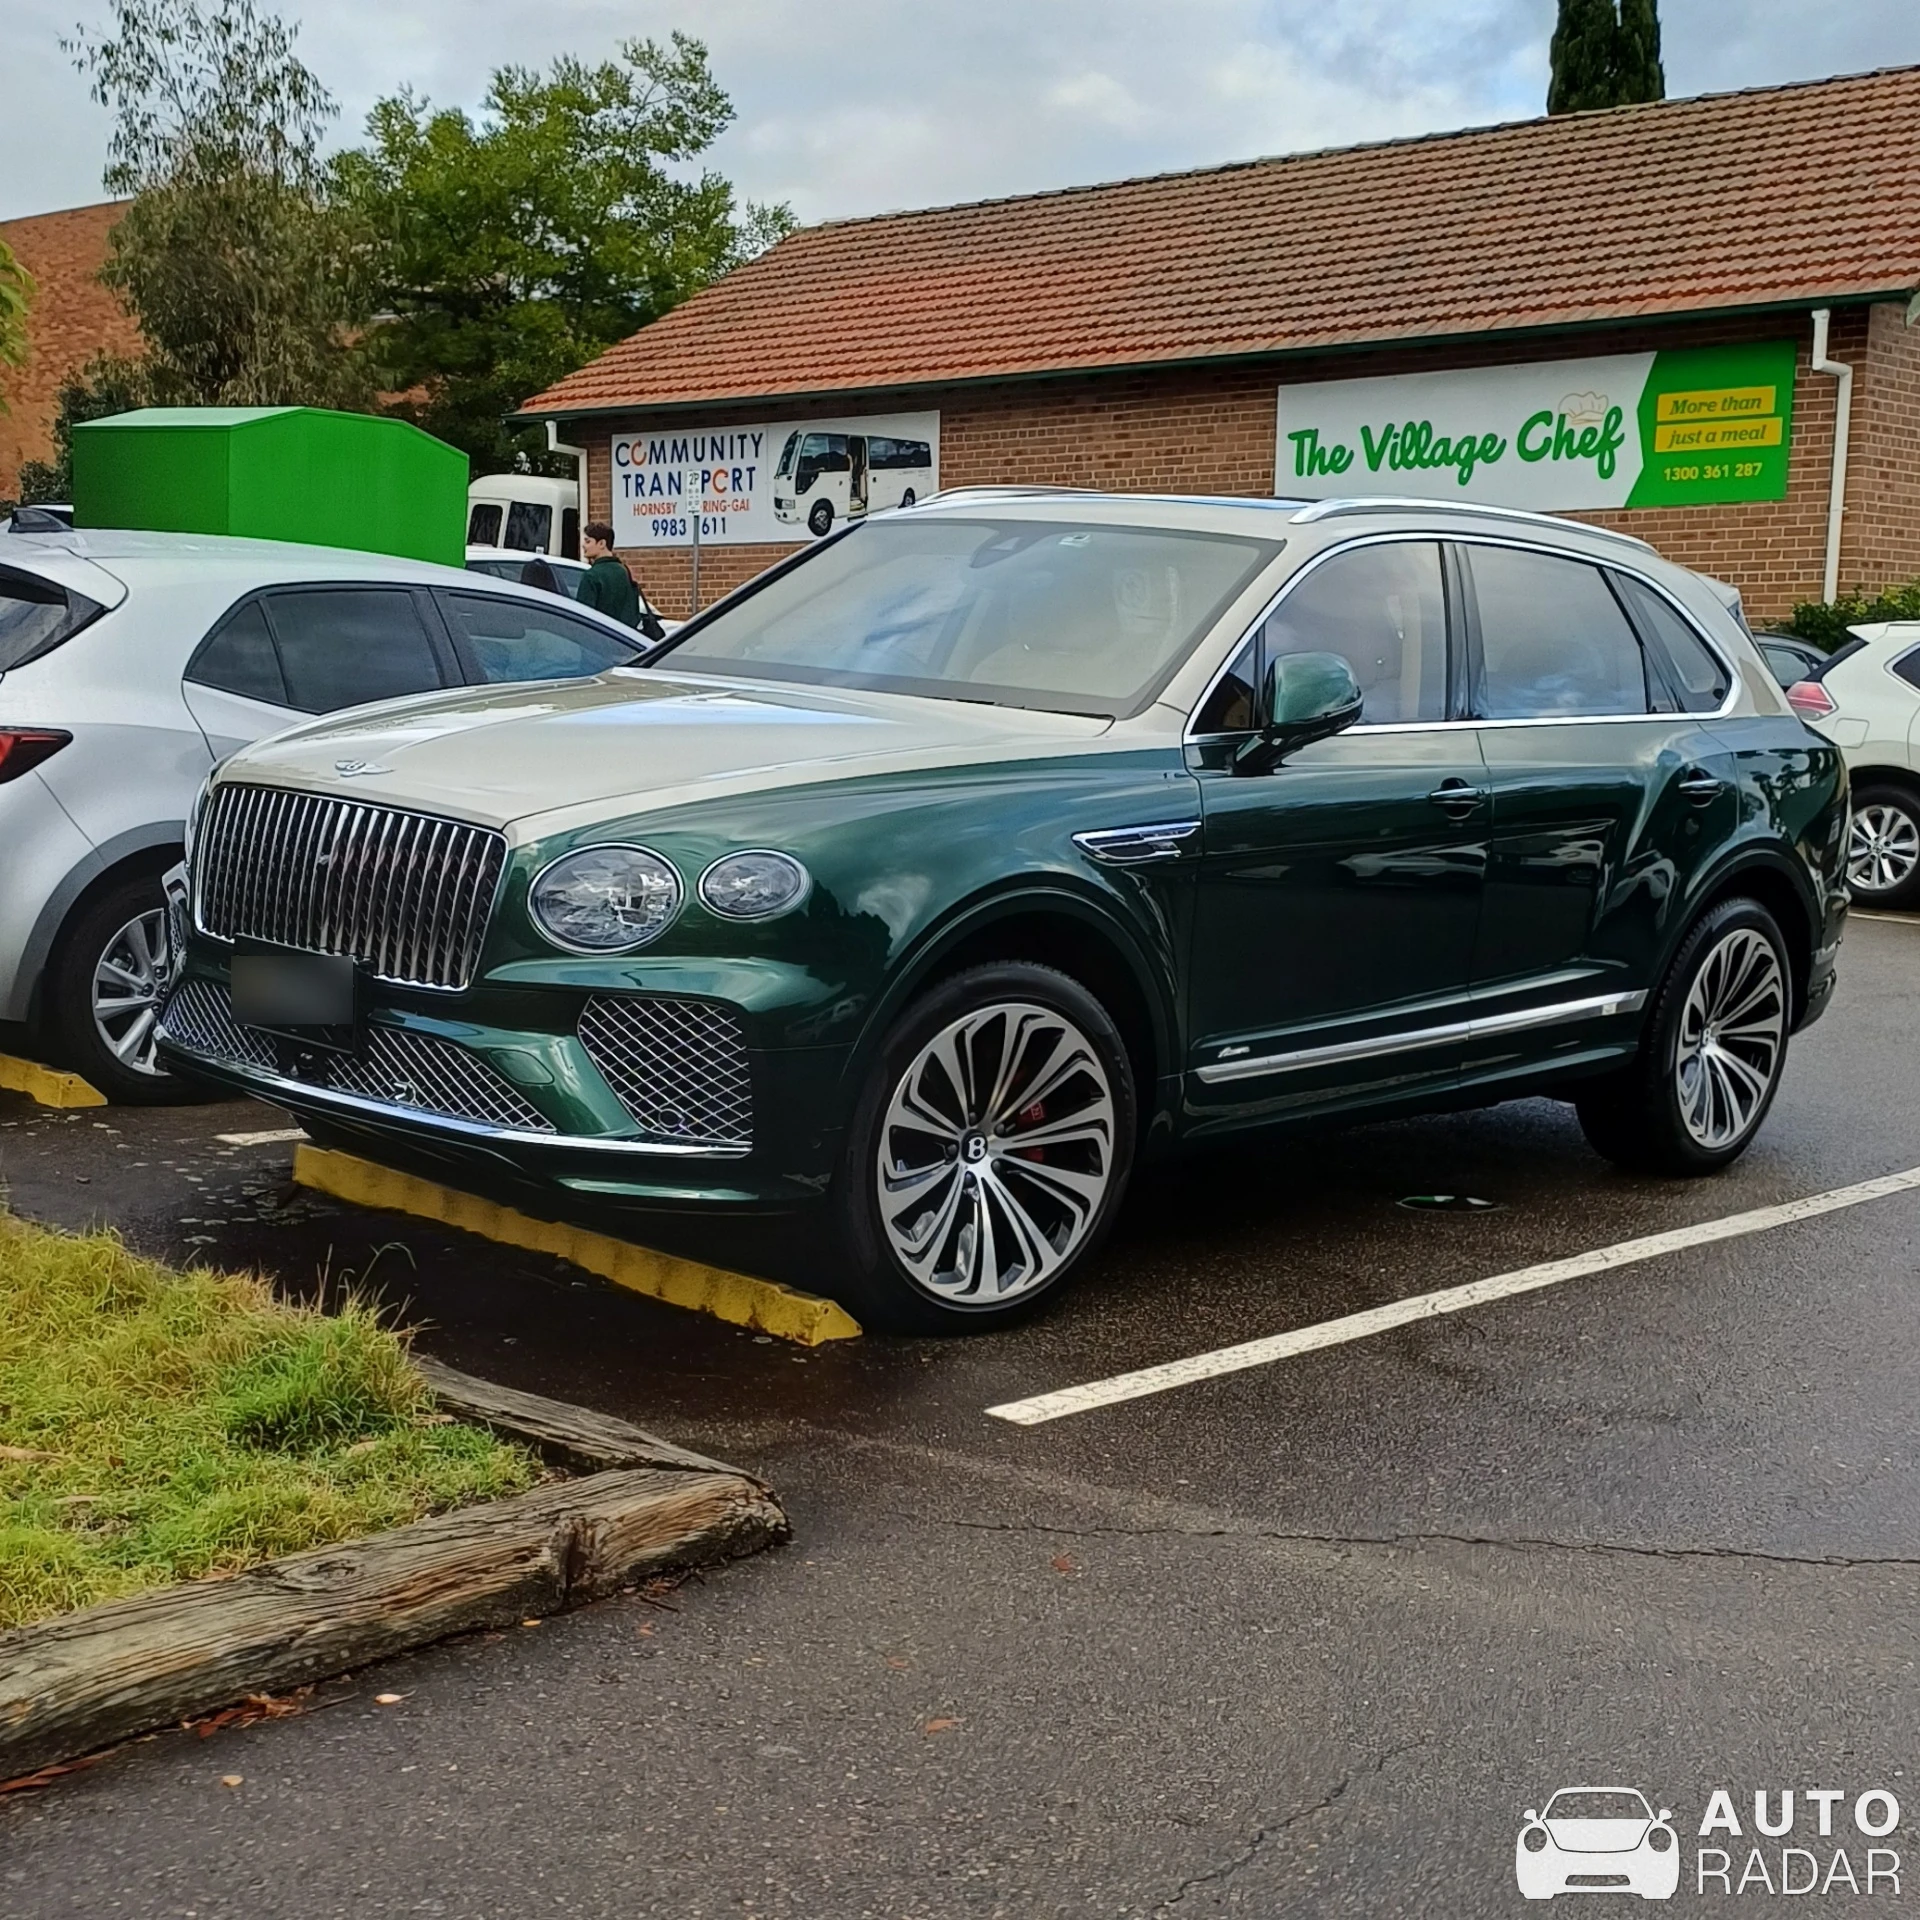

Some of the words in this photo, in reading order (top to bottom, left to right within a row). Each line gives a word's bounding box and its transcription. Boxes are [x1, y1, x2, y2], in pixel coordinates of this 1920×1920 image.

[1669, 398, 1717, 415] More
[1721, 395, 1762, 412] than
[1287, 427, 1355, 477] The
[1360, 419, 1507, 486] Village
[1516, 405, 1625, 480] Chef
[1667, 429, 1702, 449] just
[1705, 431, 1717, 443] a
[1720, 424, 1767, 442] meal
[615, 432, 764, 467] COMMUNITY
[622, 466, 756, 498] TRANPORT
[689, 472, 700, 486] 2P
[1663, 466, 1700, 481] 1300
[1702, 464, 1730, 479] 361
[1734, 462, 1763, 477] 287
[633, 501, 678, 516] HORNSBY
[652, 518, 687, 537] 9983
[967, 1136, 986, 1160] B
